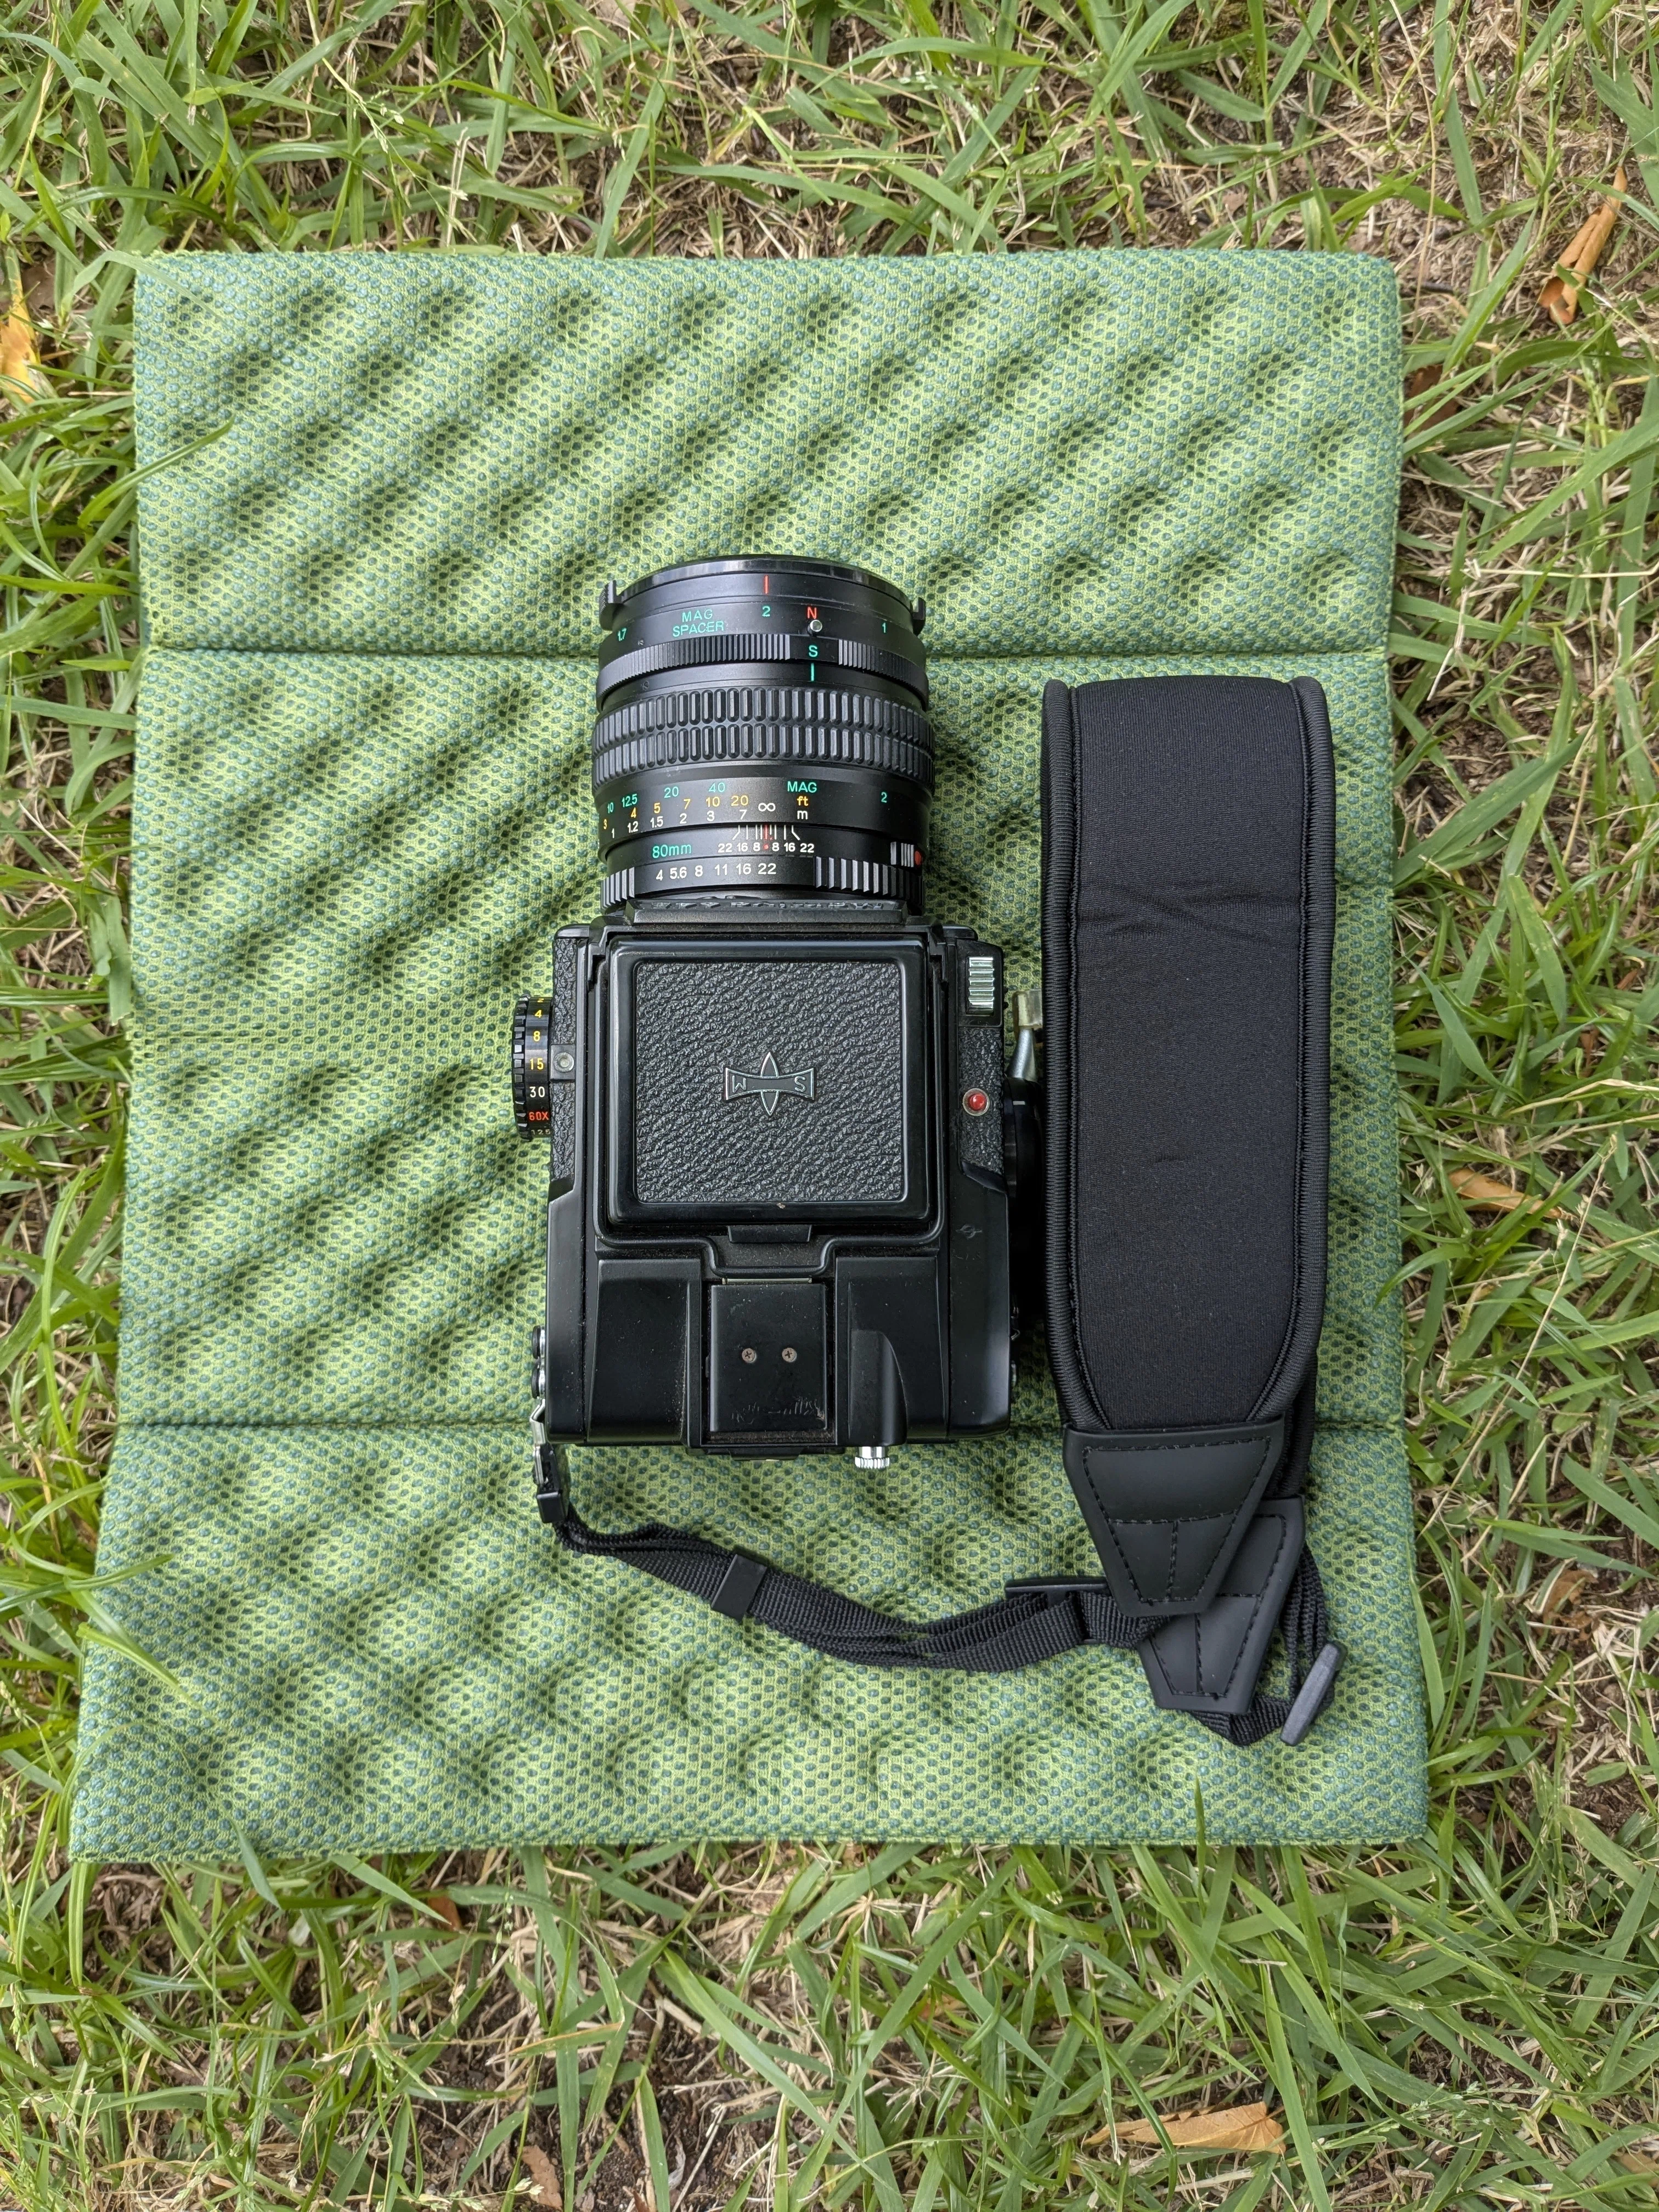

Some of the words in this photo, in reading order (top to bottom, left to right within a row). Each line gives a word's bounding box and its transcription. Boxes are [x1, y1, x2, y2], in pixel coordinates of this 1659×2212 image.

[682, 609, 713, 622] MAG
[762, 606, 770, 617] 2
[807, 607, 817, 619] N
[673, 620, 724, 637] SPACER
[882, 623, 886, 633] 1
[617, 628, 627, 641] 1.7
[808, 645, 818, 657] S
[607, 802, 614, 814] 10
[622, 794, 637, 808] 12.5
[664, 786, 679, 798] 20
[708, 782, 725, 792] 40
[787, 781, 817, 793] MAG
[881, 792, 887, 803] 2
[603, 819, 607, 830] 3
[631, 807, 636, 818] 4
[654, 803, 661, 814] 5
[683, 798, 691, 810] 7
[706, 796, 720, 807] 10
[731, 795, 748, 806] 20
[797, 795, 809, 806] ft
[611, 828, 614, 838] 1
[628, 821, 639, 833] 1.2
[650, 816, 663, 828] 1.5
[679, 813, 687, 824] 2
[707, 810, 715, 821] 3
[739, 809, 747, 820] 7
[797, 810, 808, 820] m
[652, 844, 691, 859] 80mm
[718, 843, 732, 853] 22
[737, 843, 748, 852] 16
[753, 842, 760, 852] 8
[772, 842, 780, 852] 8
[784, 843, 795, 852] 16
[800, 843, 815, 853] 22
[656, 869, 663, 881] 4
[670, 867, 687, 879] 5.6
[695, 865, 703, 877] 8
[714, 864, 727, 876] 11
[736, 863, 752, 875] 16
[758, 863, 776, 875] 22
[534, 1010, 542, 1018] 4
[533, 1031, 540, 1042] 8
[529, 1058, 544, 1070] 15
[529, 1086, 545, 1098] 30
[529, 1111, 549, 1121] 60X
